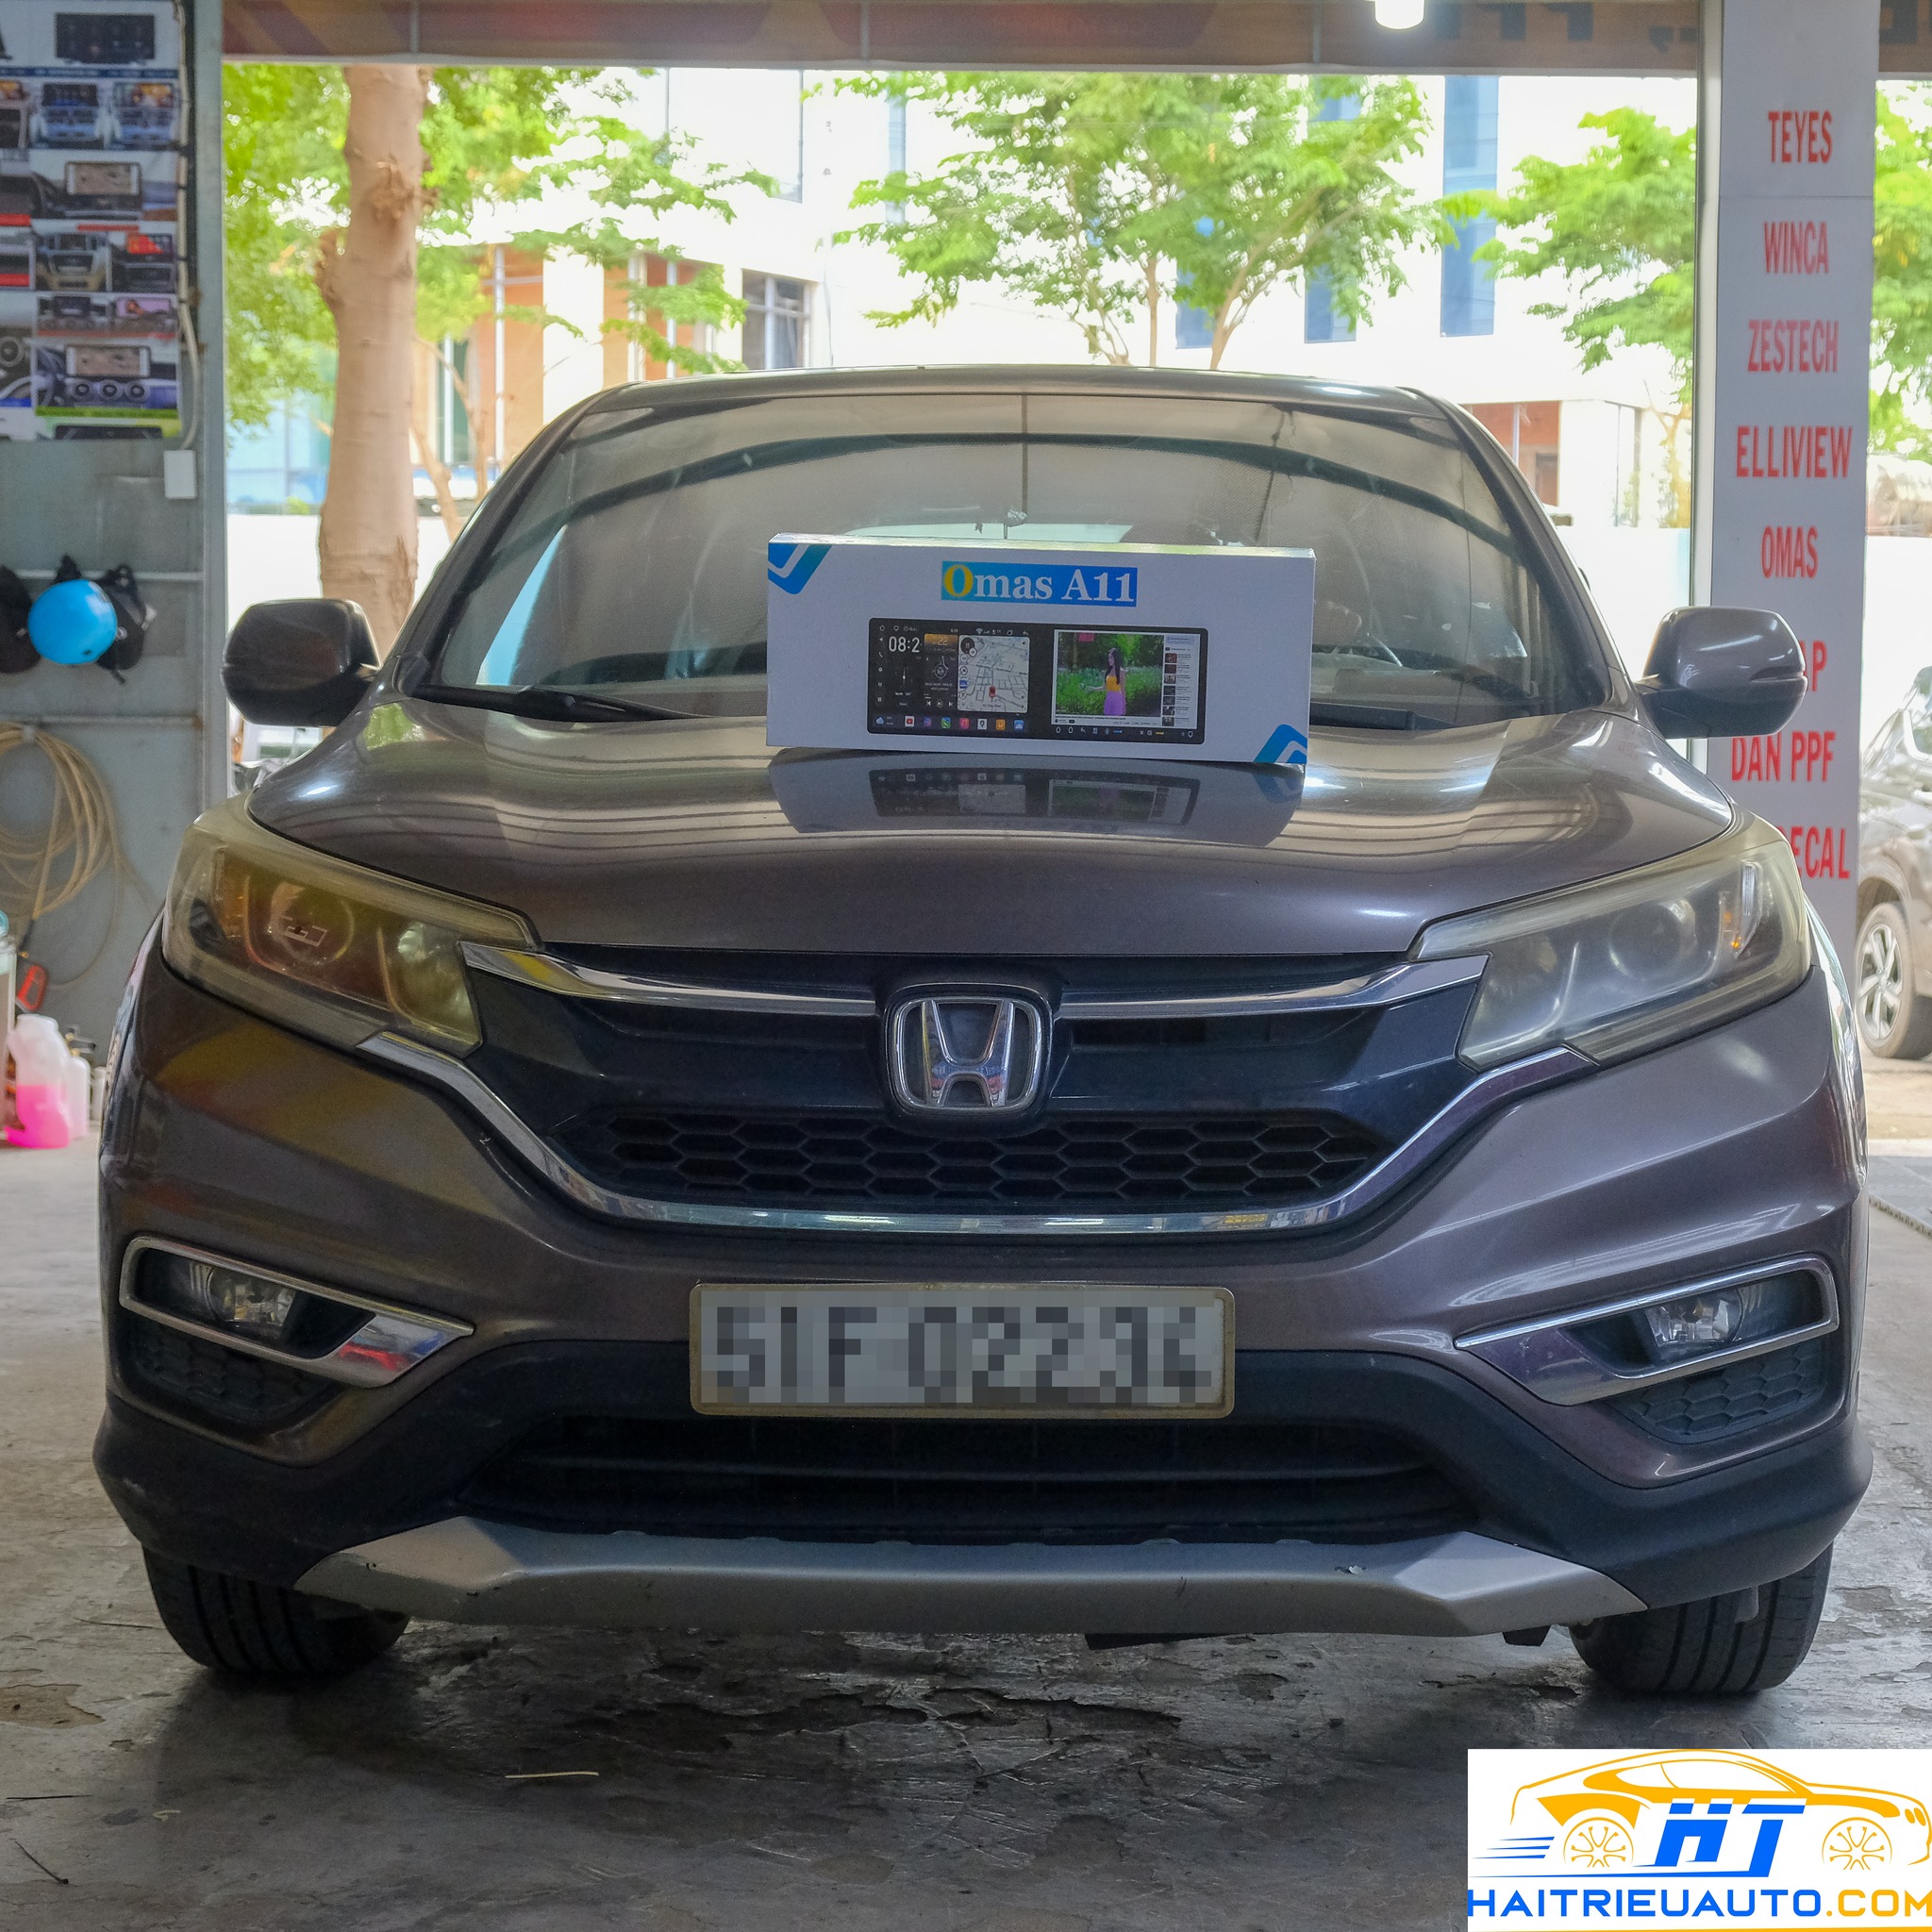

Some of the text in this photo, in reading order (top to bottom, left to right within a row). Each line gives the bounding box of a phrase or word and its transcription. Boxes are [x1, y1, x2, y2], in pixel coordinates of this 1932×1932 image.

[1768, 110, 1833, 163] TEYES
[1763, 221, 1829, 274] WINCA
[1747, 319, 1840, 373] ZESTECH
[1736, 425, 1853, 478] ELLIVIEW
[1761, 525, 1819, 578] OMAS
[944, 564, 1135, 602] Omas A11
[1731, 730, 1837, 782] DAN PPF
[1778, 824, 1851, 879] ECAL
